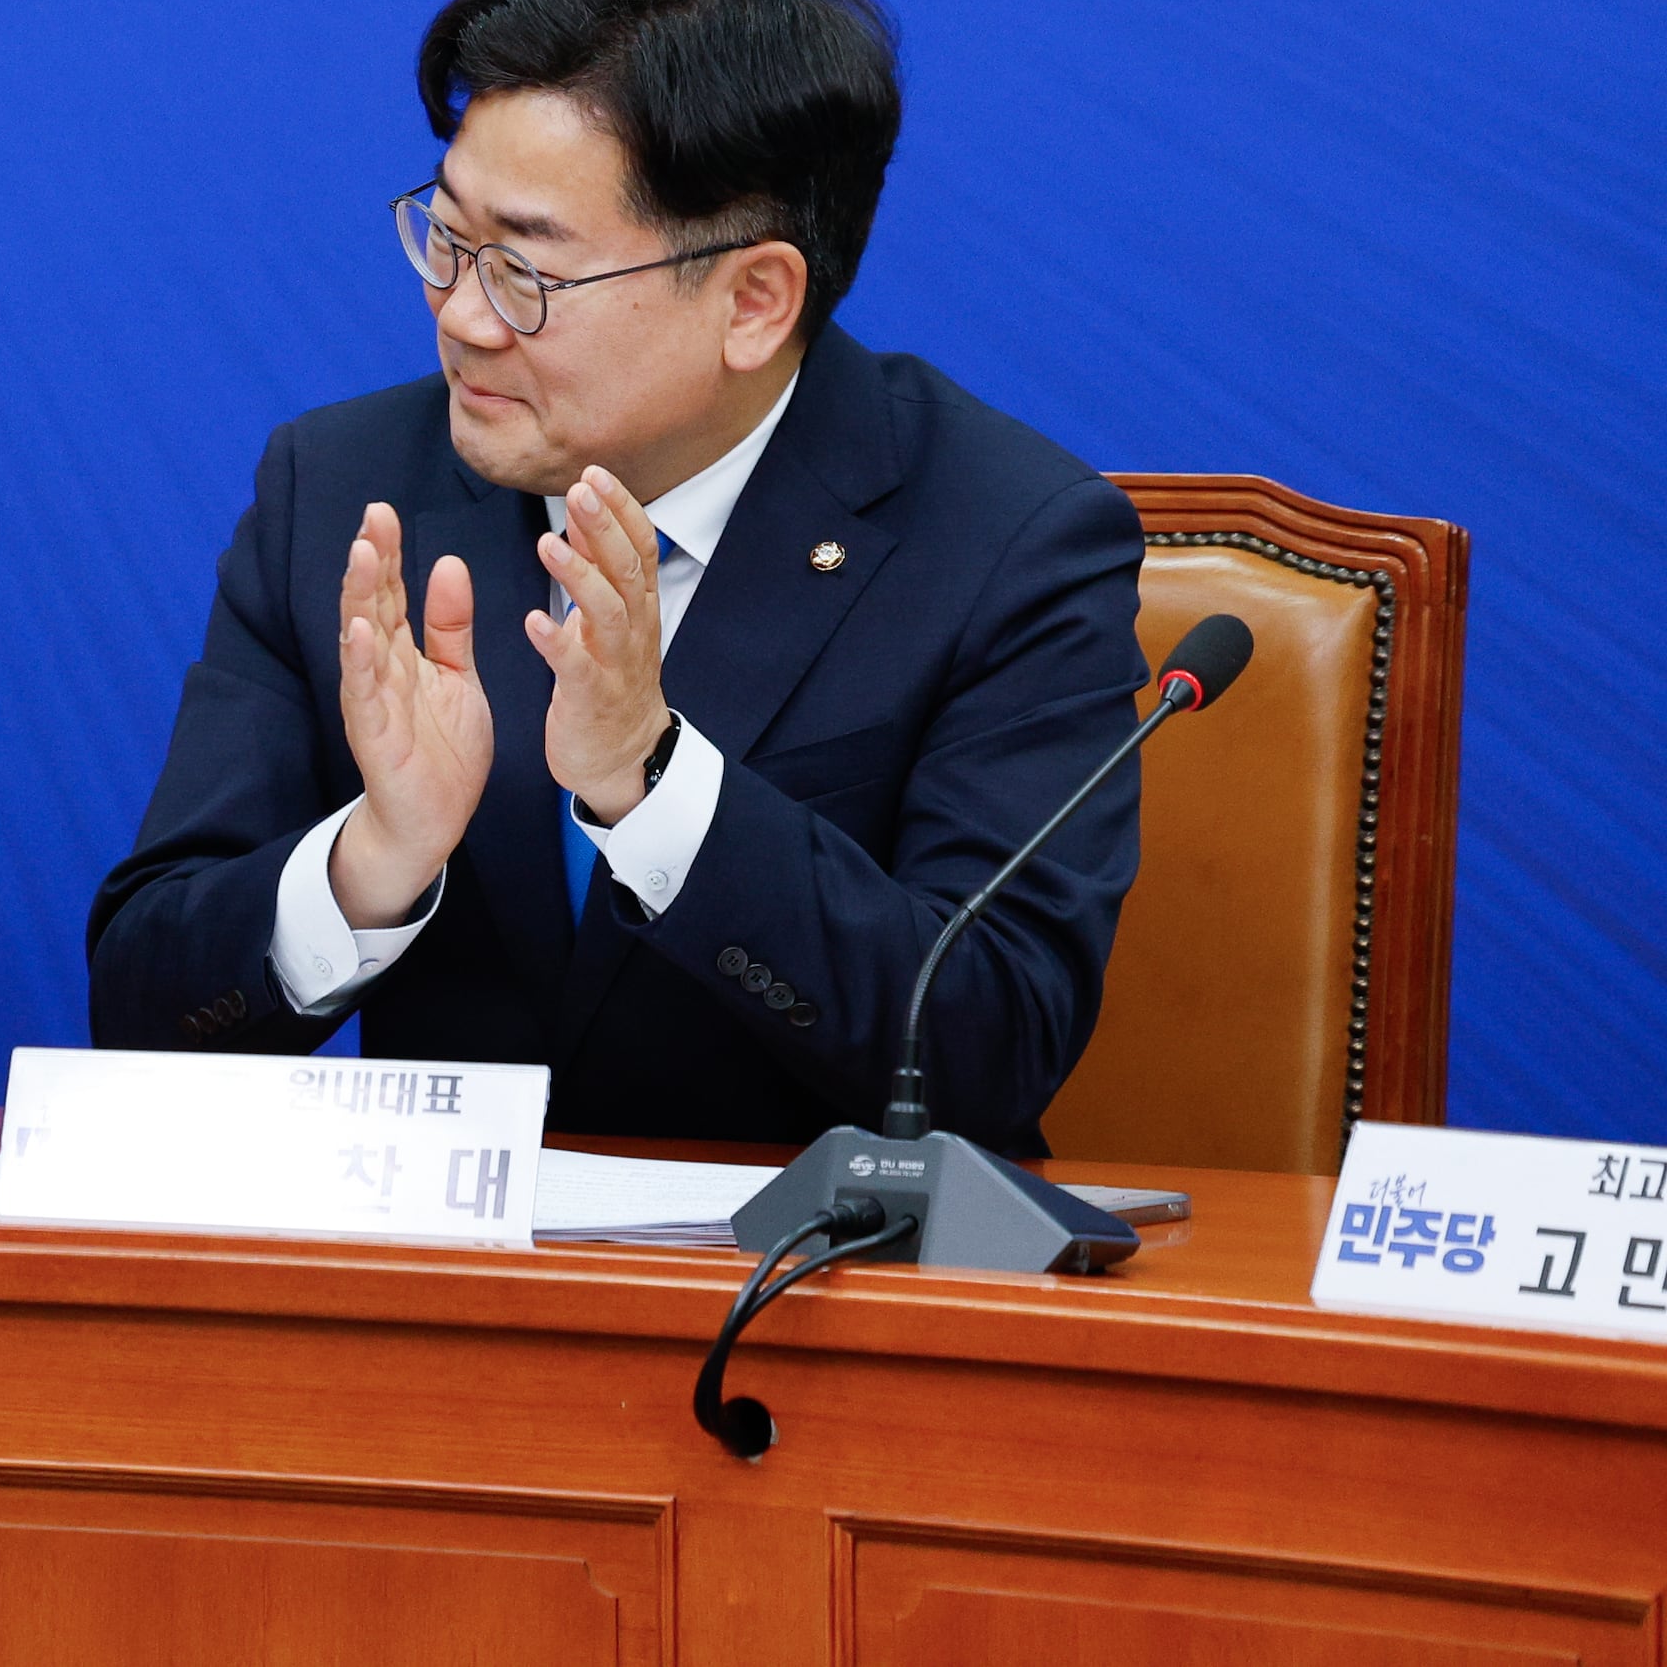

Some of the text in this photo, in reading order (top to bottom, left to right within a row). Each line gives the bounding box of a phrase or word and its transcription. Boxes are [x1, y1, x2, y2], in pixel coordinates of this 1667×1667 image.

[288, 1068, 463, 1116] 원내대표
[1368, 1173, 1427, 1209] 더불어
[1337, 1202, 1497, 1274] 민주당
